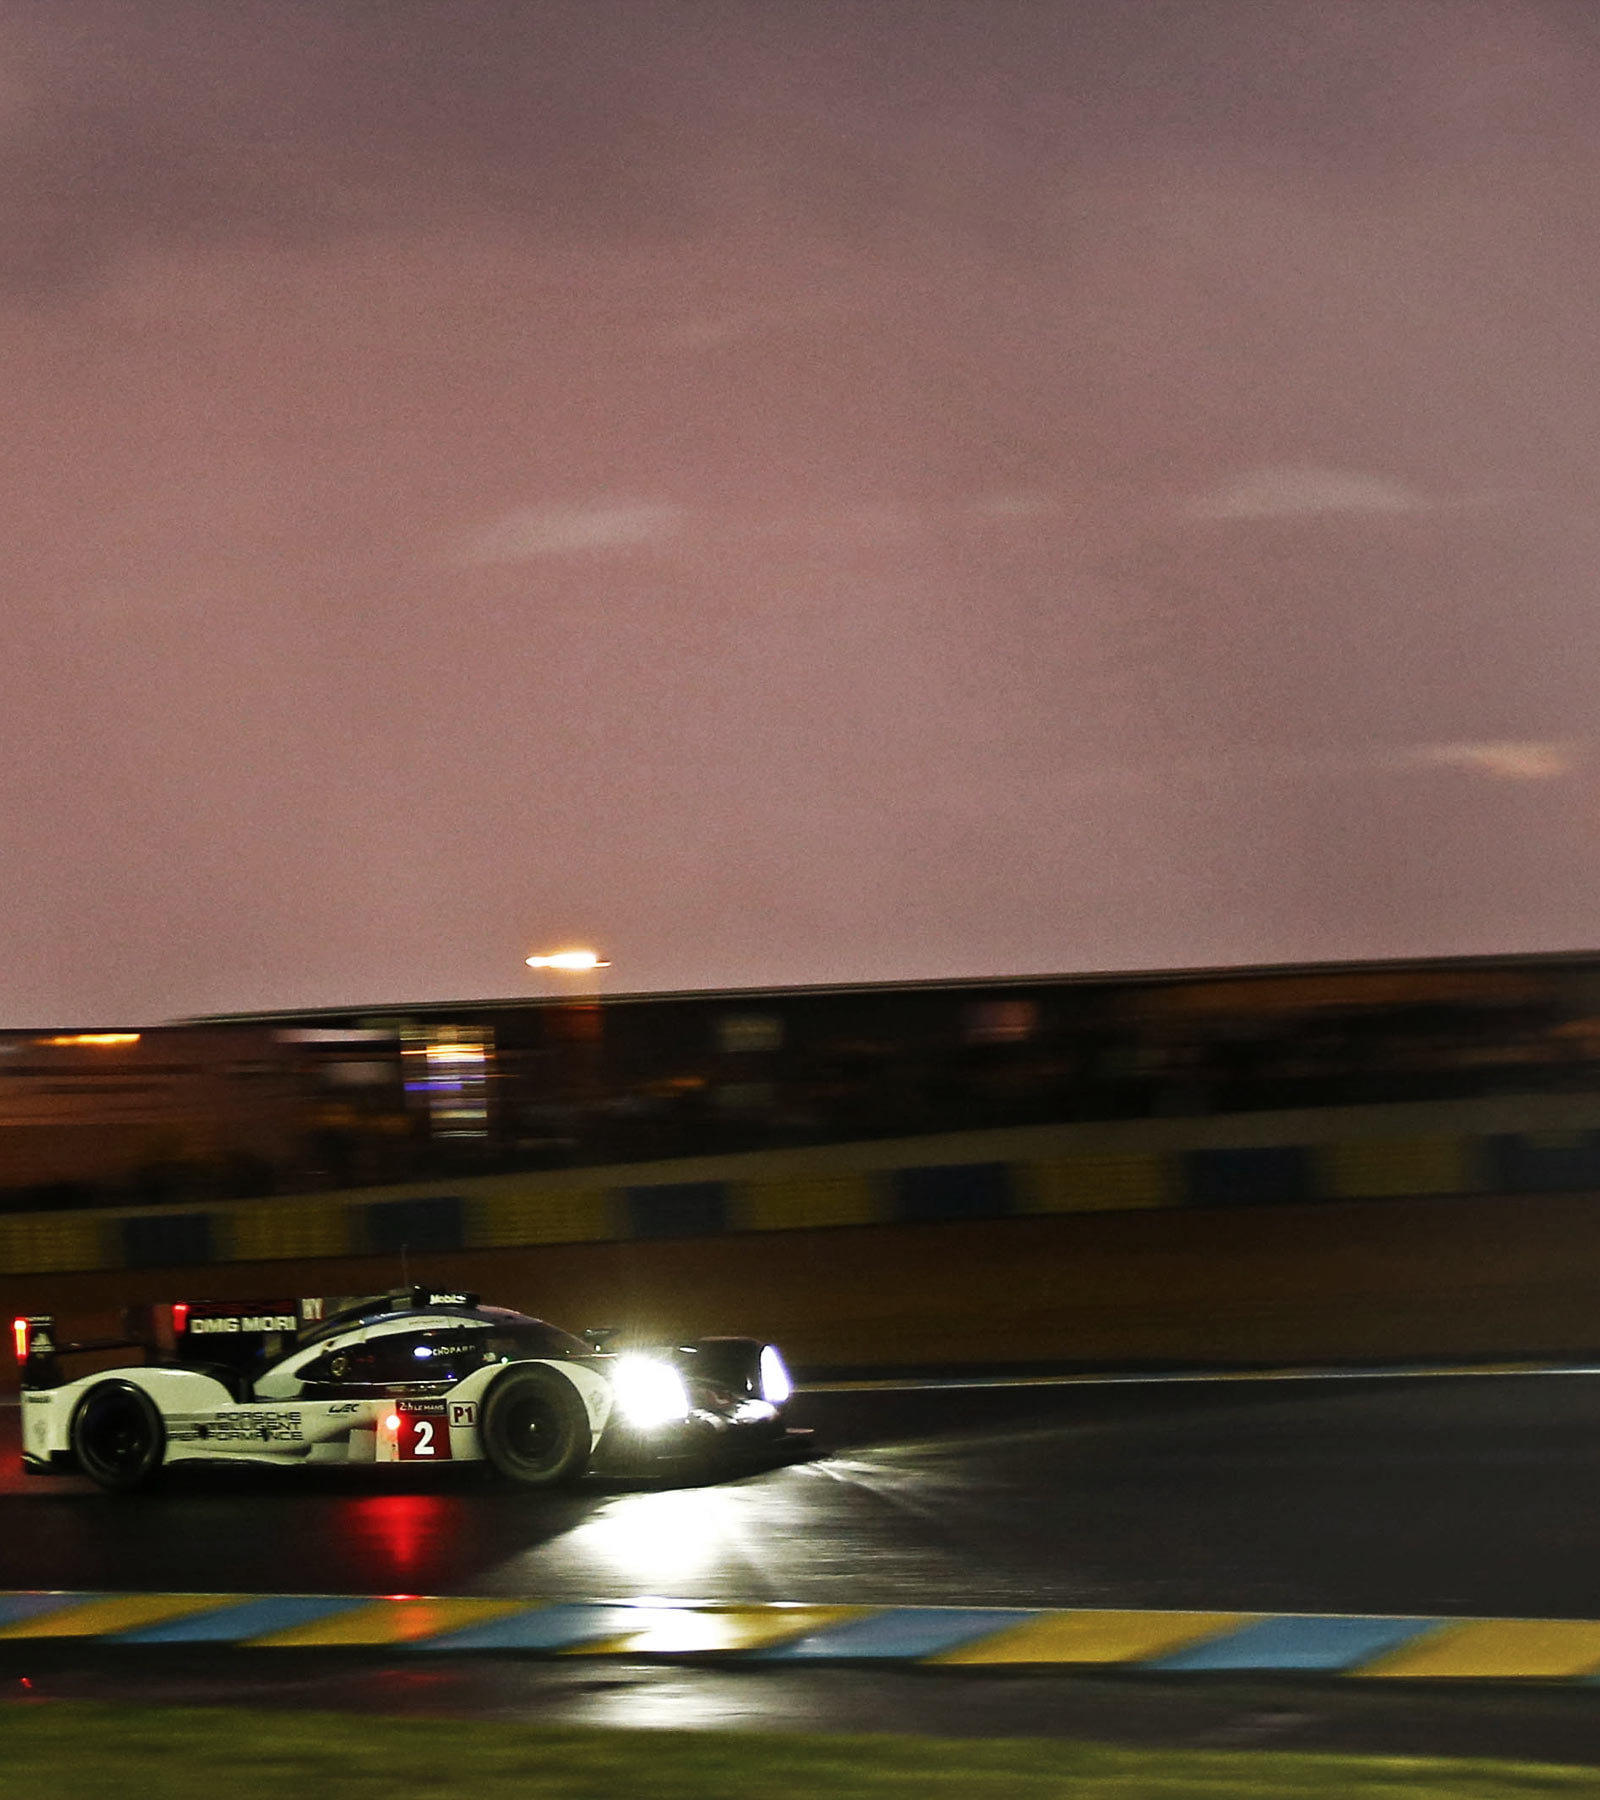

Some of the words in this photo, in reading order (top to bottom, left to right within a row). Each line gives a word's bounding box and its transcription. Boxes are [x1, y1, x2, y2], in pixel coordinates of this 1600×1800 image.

[190, 1318, 239, 1333] DMG
[241, 1316, 297, 1331] MORI
[328, 1403, 360, 1413] WEC
[454, 1407, 473, 1423] P1
[215, 1412, 301, 1421] PORSCHE
[414, 1421, 435, 1455] 2
